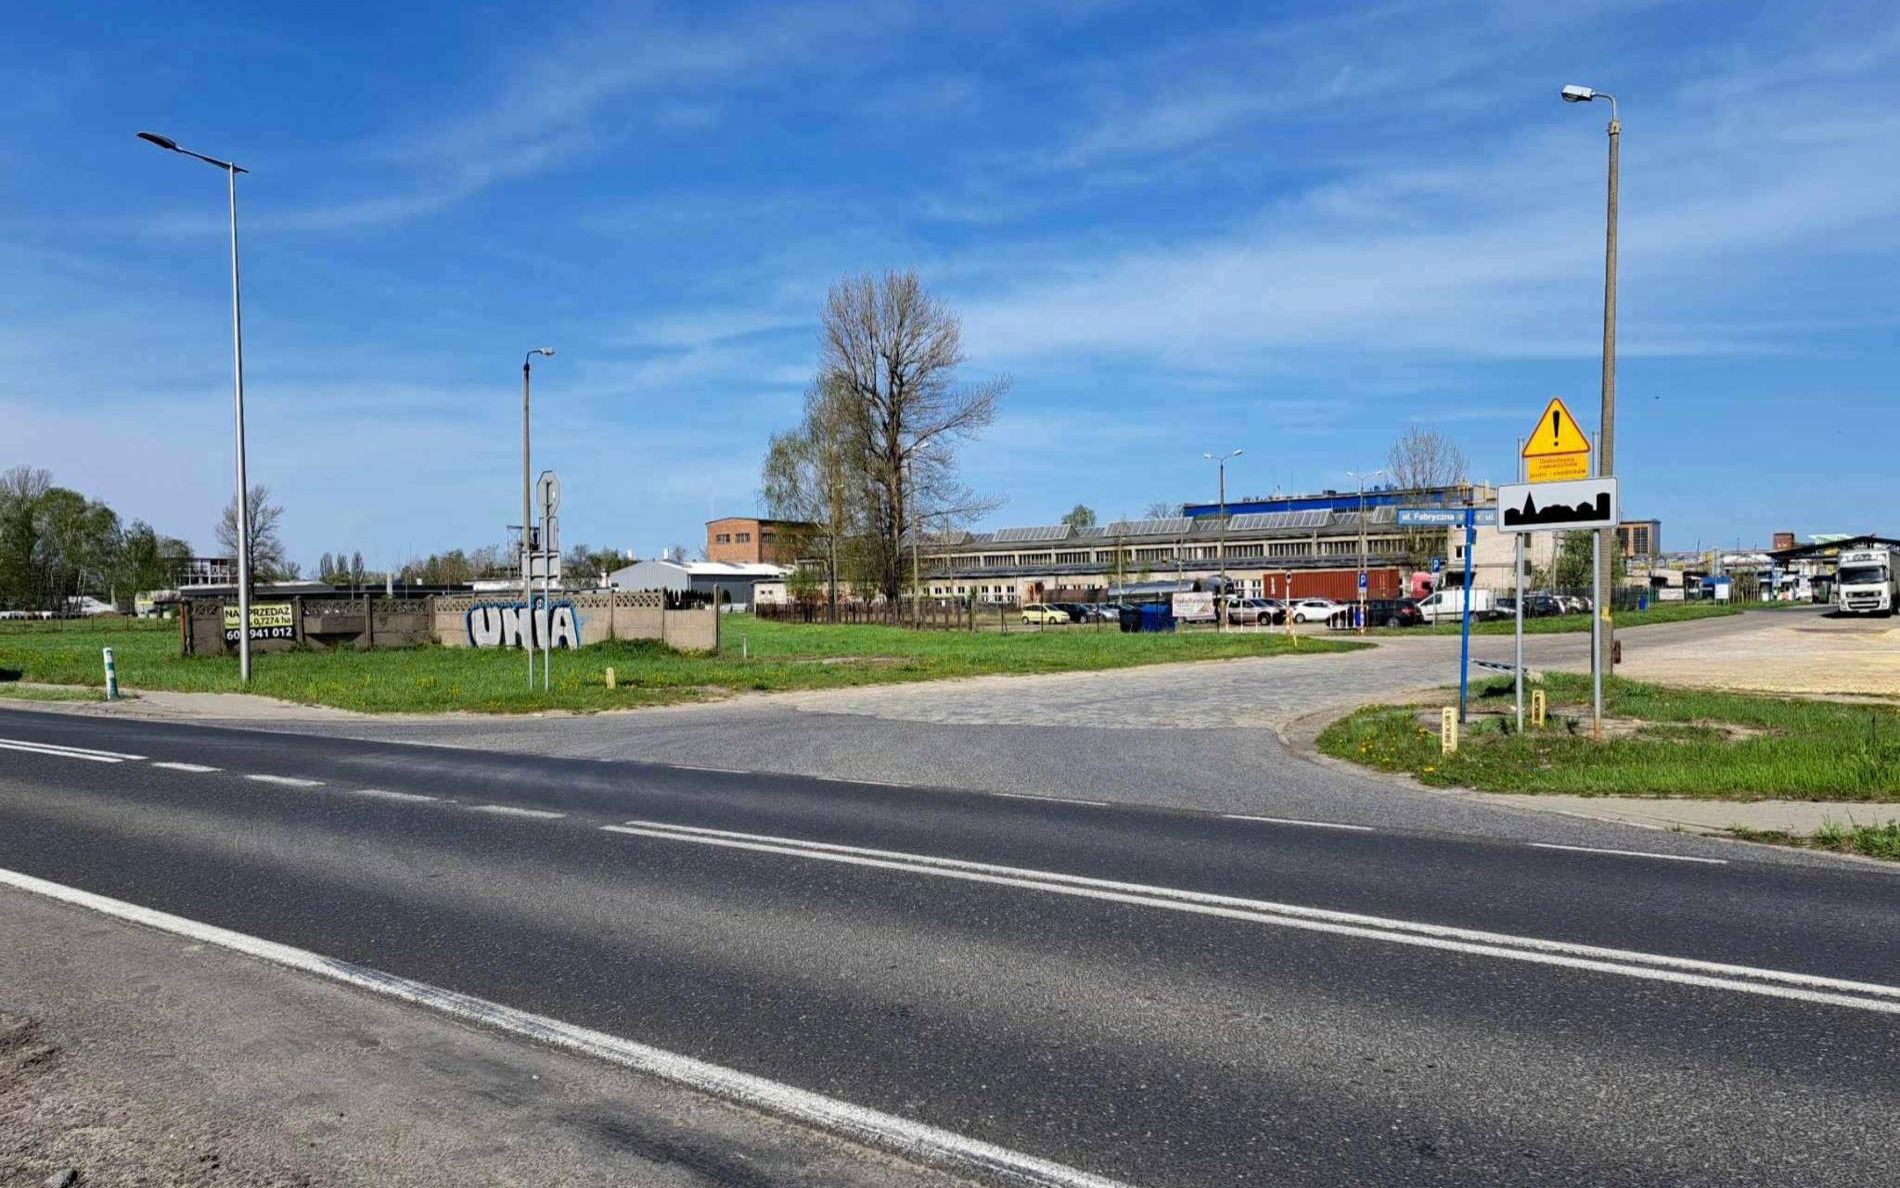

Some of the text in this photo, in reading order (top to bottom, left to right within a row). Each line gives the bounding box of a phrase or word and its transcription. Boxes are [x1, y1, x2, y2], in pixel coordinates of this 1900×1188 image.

[1414, 512, 1455, 522] Fabryczna
[225, 609, 240, 618] NA
[249, 628, 269, 639] 941
[272, 626, 293, 637] 012
